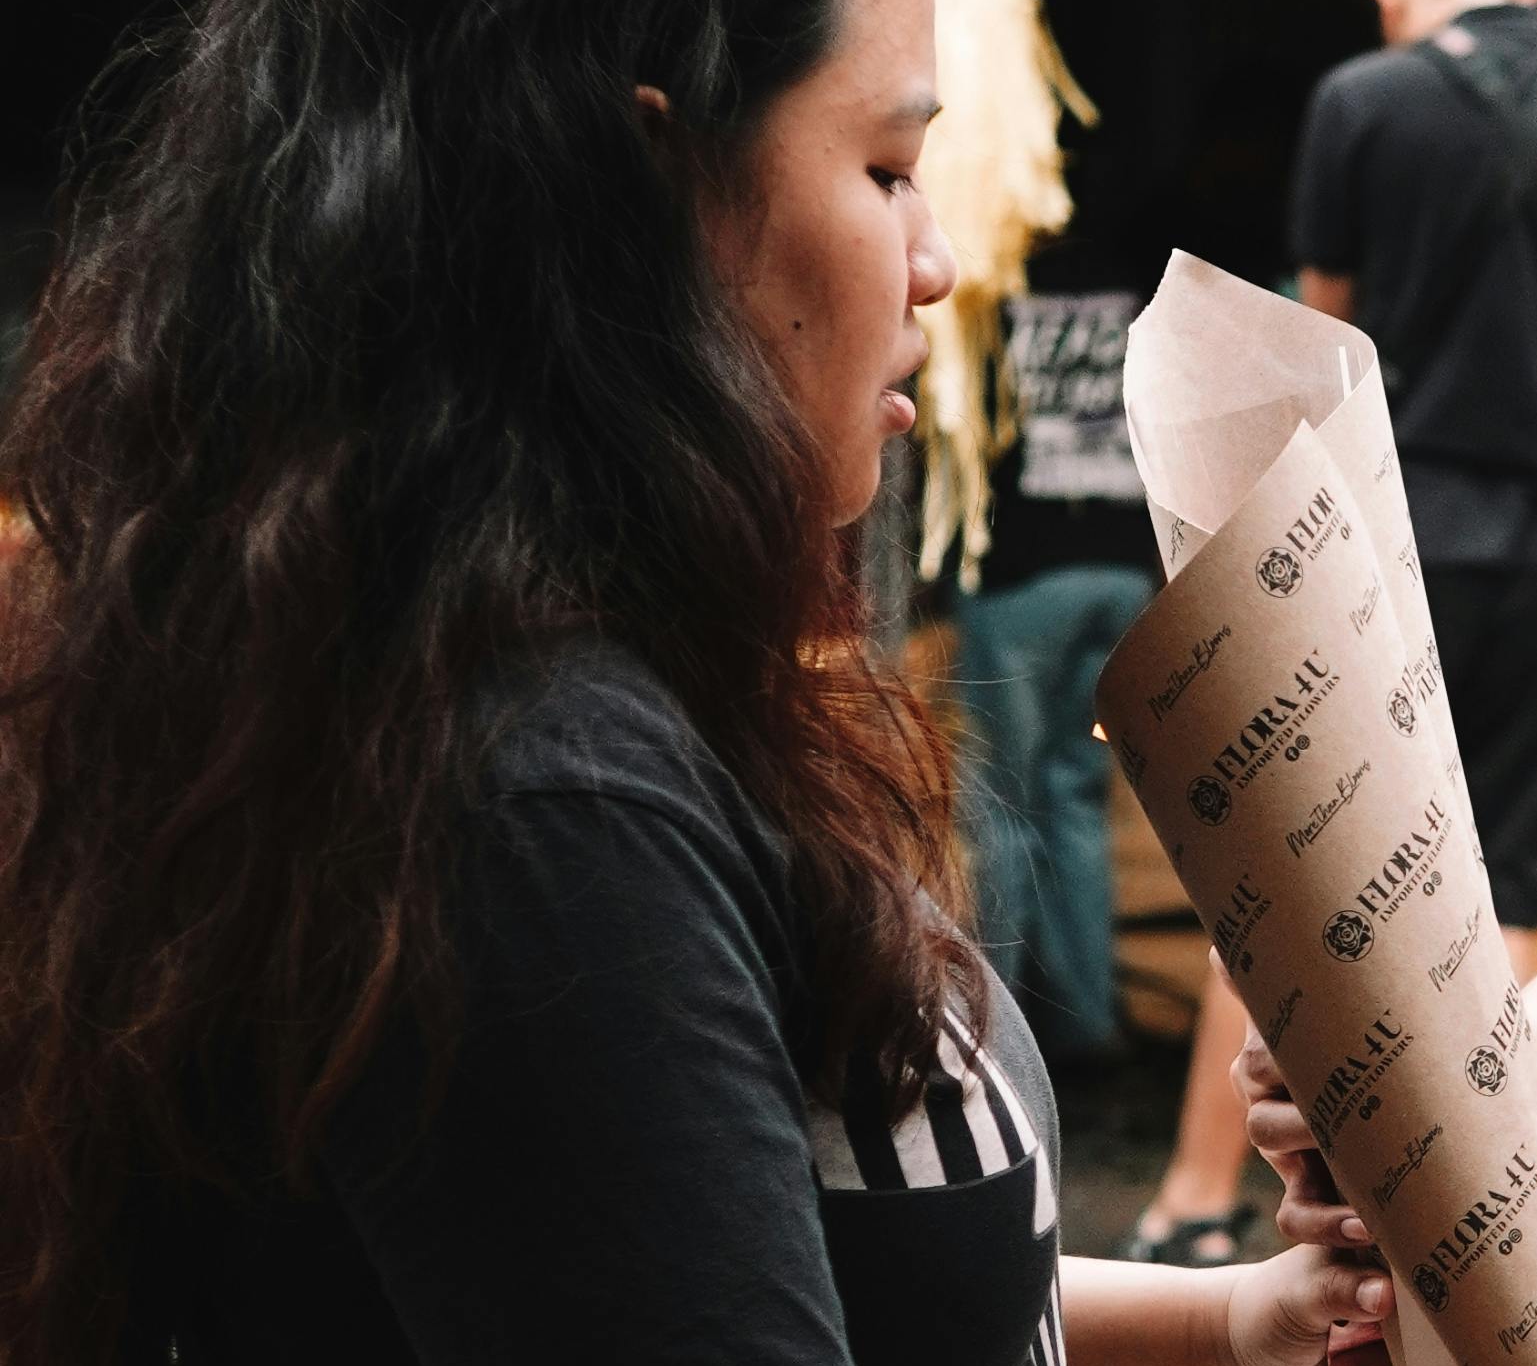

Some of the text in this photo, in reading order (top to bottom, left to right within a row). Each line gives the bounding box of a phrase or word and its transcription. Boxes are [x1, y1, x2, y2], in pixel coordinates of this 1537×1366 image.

[1213, 695, 1300, 782] FLORA
[1236, 675, 1341, 790] IMPORTED FLOWERS
[1356, 831, 1432, 916] FLORA
[1378, 862, 1430, 923] IMPORTED
[1313, 1055, 1370, 1125] FLORA
[1363, 1034, 1415, 1090] FLOWERS
[1430, 1188, 1511, 1275] FLORA
[1451, 1221, 1507, 1283] IMPORTED
